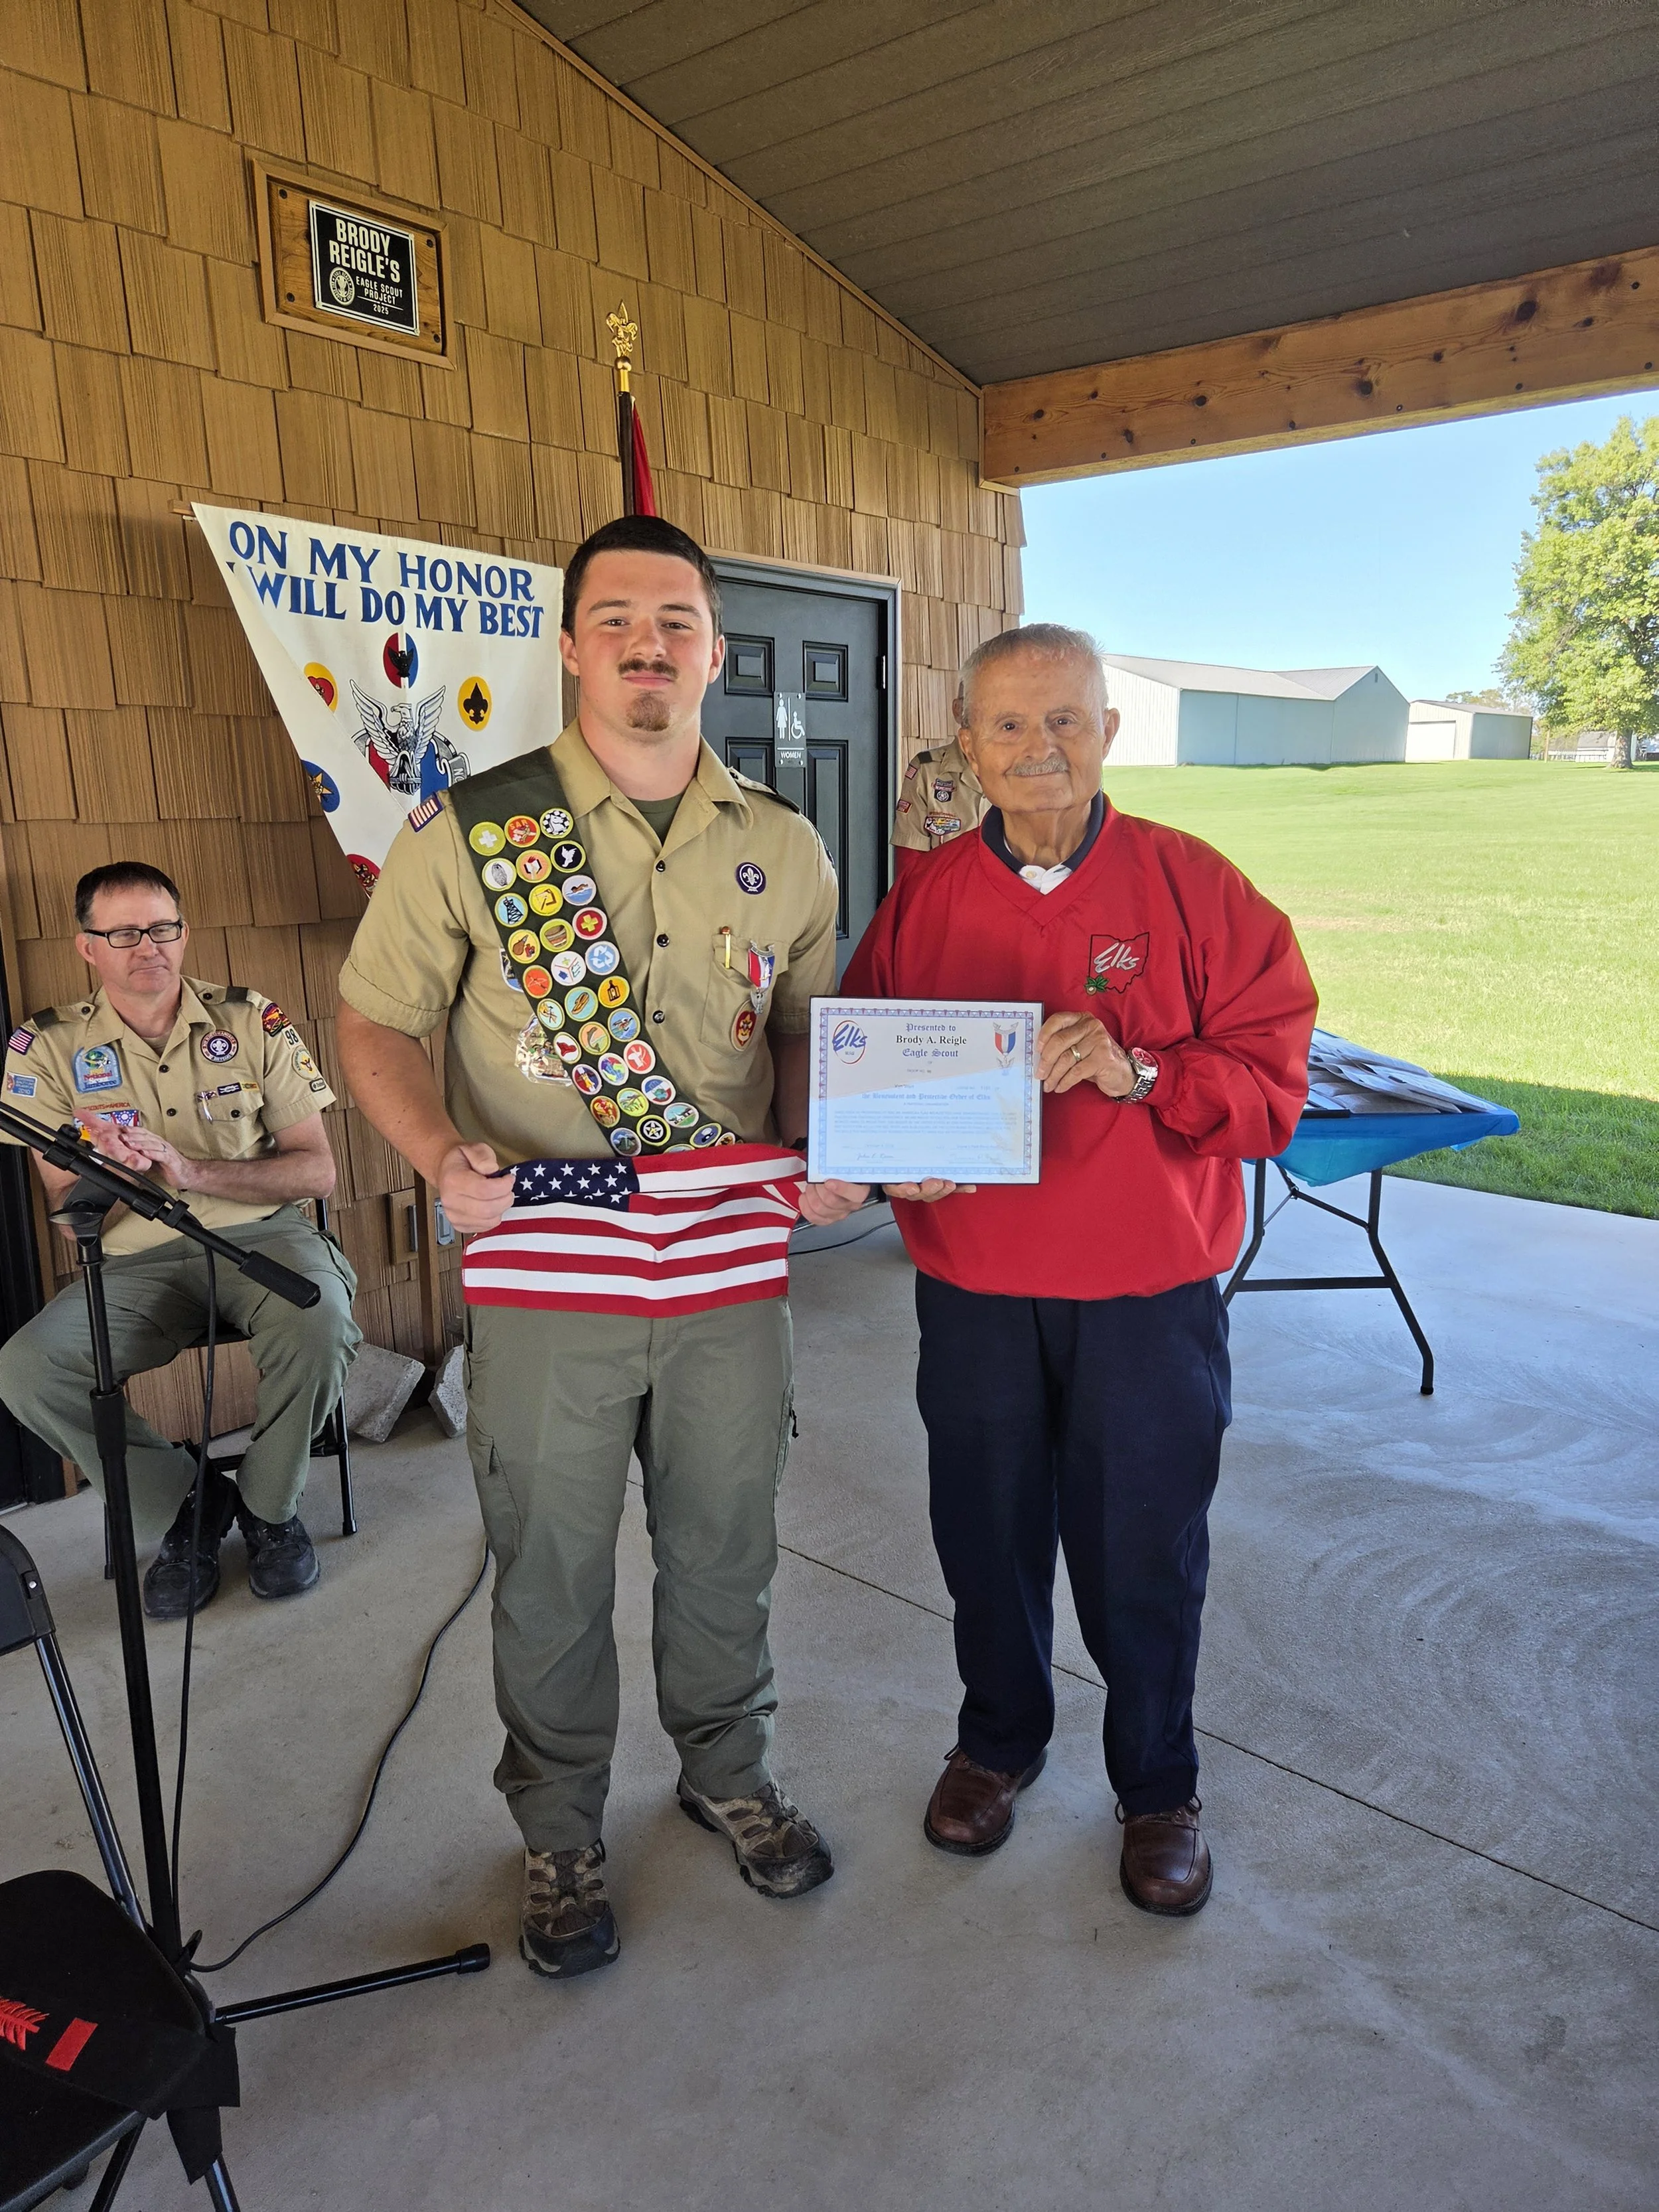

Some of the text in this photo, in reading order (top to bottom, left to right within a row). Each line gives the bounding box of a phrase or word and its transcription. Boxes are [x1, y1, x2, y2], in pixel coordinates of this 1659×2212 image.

[336, 218, 390, 256] BRODY
[329, 240, 400, 283] REIGLE'S
[356, 276, 378, 291] EAGLE
[380, 283, 403, 298] SCOUT
[364, 288, 396, 305] PROJECT
[373, 304, 389, 315] 2025
[229, 521, 535, 601] ON MY HONOR
[246, 564, 544, 638] WILL DO MY BEST
[510, 820, 528, 830] SAR
[1094, 942, 1140, 974] Elks
[906, 1023, 946, 1032] Presented
[285, 1029, 299, 1045] 98
[832, 1024, 867, 1051] Elks
[896, 1035, 924, 1045] Brody
[940, 1036, 967, 1046] Reigle
[902, 1049, 928, 1058] Eagle
[84, 1070, 113, 1081] National
[83, 1079, 117, 1089] Jamboree
